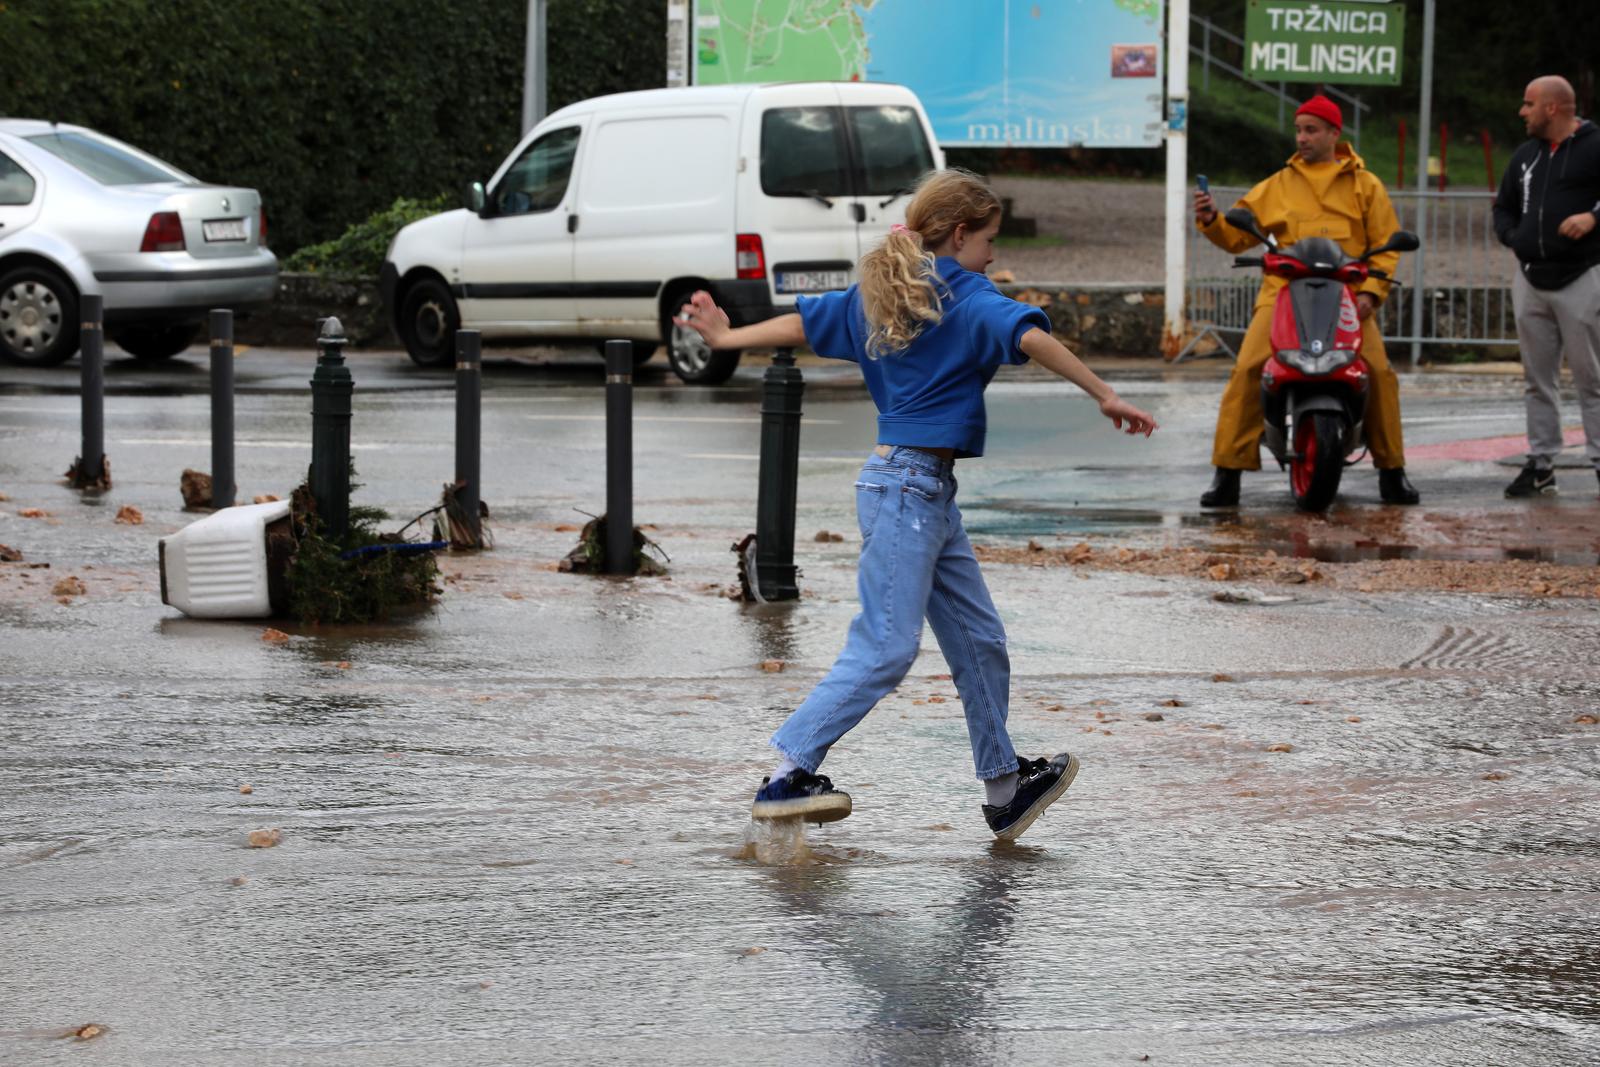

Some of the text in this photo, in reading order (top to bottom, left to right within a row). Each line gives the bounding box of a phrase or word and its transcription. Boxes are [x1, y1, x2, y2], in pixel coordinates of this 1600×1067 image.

[1266, 4, 1387, 34] TRŽNICA
[1251, 41, 1396, 75] MALINSKA
[968, 116, 1132, 140] malinska
